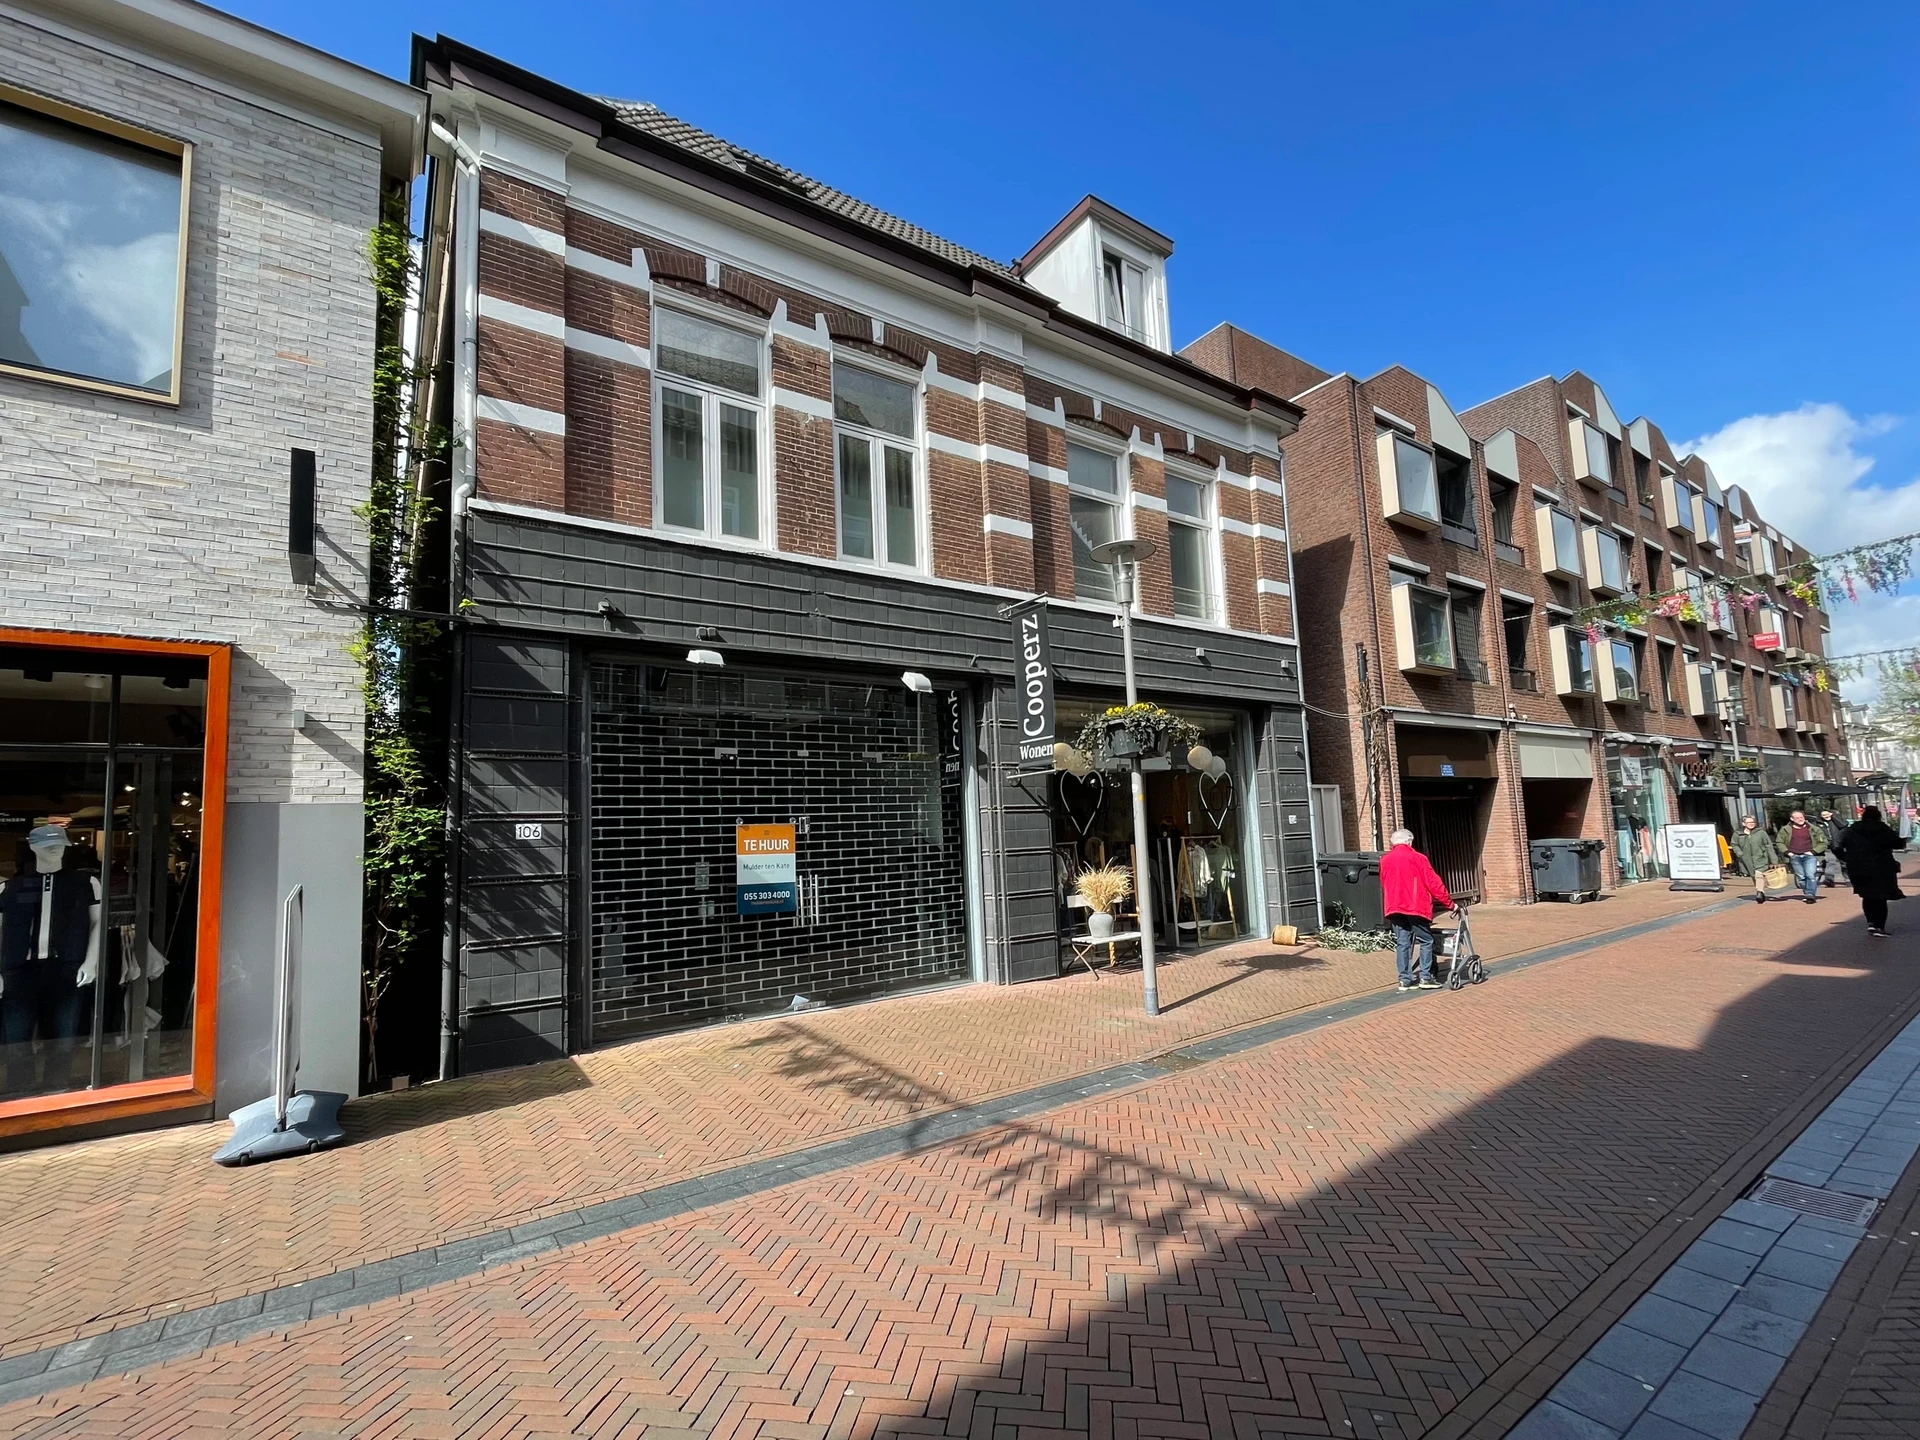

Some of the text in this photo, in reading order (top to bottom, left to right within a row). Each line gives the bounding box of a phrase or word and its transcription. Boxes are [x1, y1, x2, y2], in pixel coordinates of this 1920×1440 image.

[1021, 613, 1048, 737] Cooperz
[1019, 743, 1054, 760] Wonen
[518, 826, 540, 838] 106
[743, 839, 790, 851] TE HUUR
[1673, 838, 1695, 849] 30
[743, 863, 764, 871] Mulder
[743, 890, 790, 901] 055 303 4000
